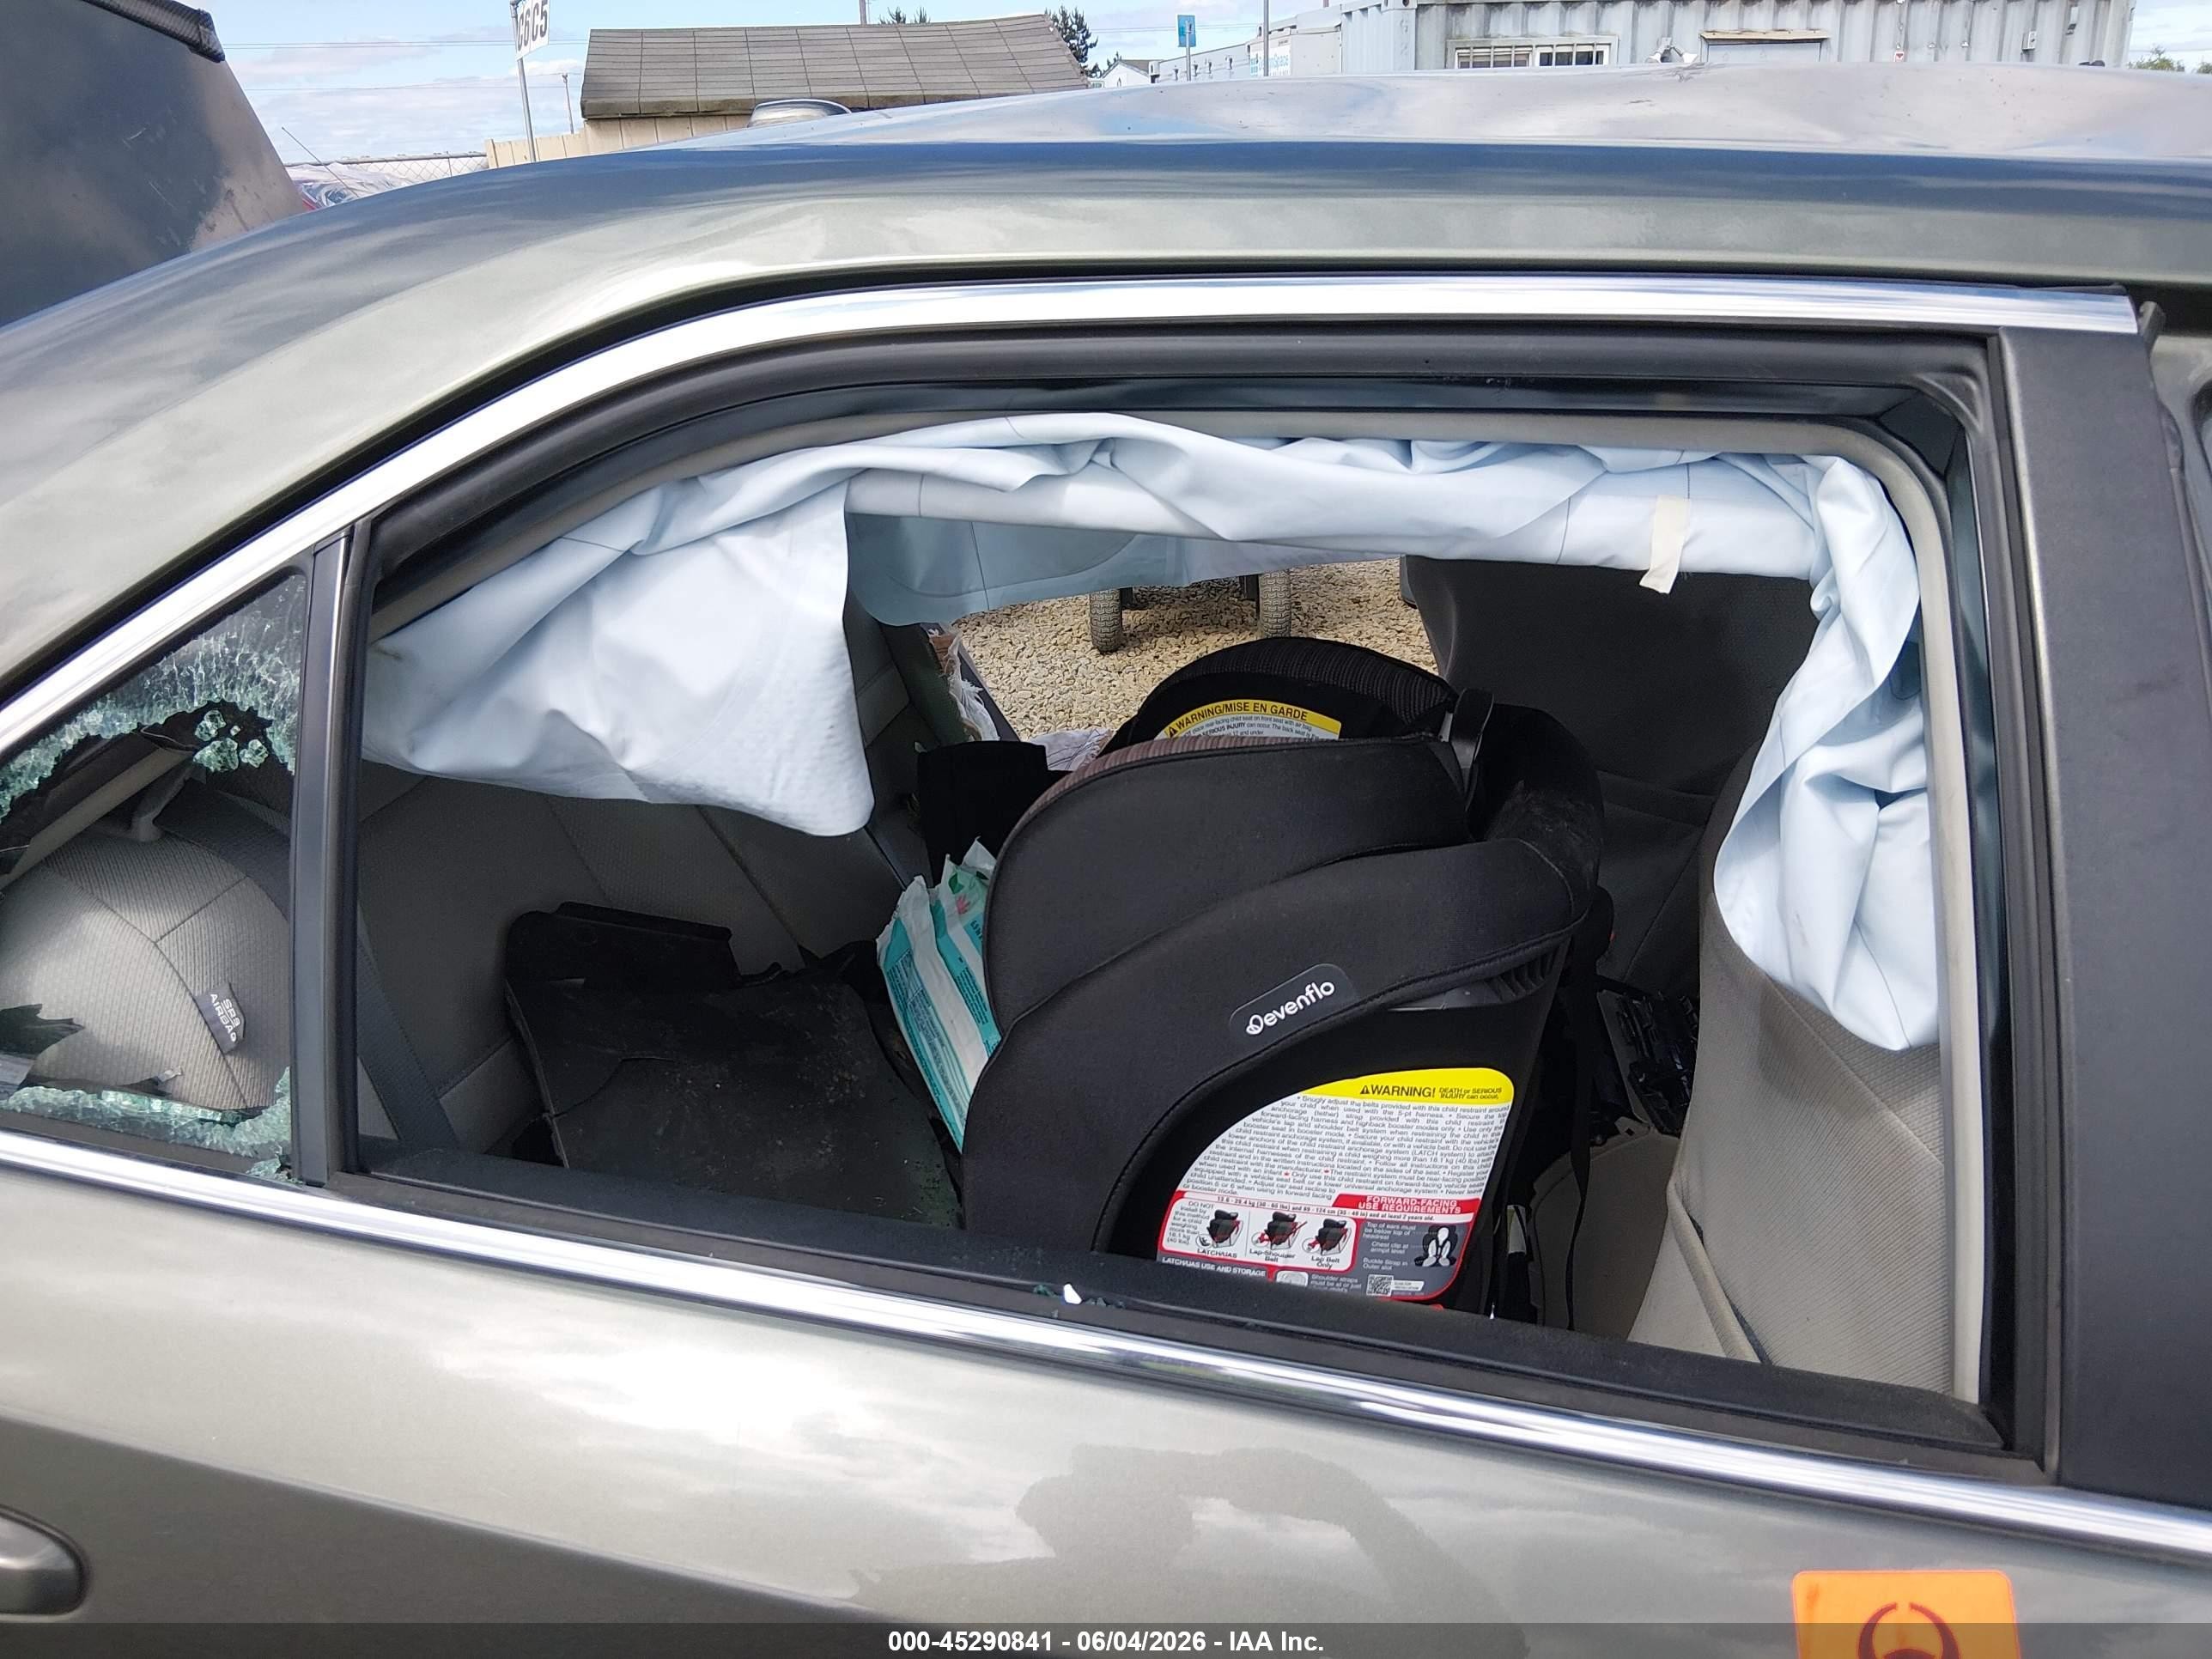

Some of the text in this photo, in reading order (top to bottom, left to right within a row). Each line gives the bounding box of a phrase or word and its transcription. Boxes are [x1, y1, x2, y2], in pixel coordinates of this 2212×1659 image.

[518, 0, 548, 52] C6 C5
[1176, 702, 1308, 730] WARNING/MISE EN GARDE
[1264, 981, 1335, 1026] evenflo
[1370, 1085, 1437, 1098] WARNING!
[1358, 1201, 1462, 1214] USE REQUIREMENTS
[1366, 1195, 1457, 1208] FORWARD-FACING
[1232, 1267, 1267, 1277] STORAGE
[1316, 1261, 1333, 1270] Only
